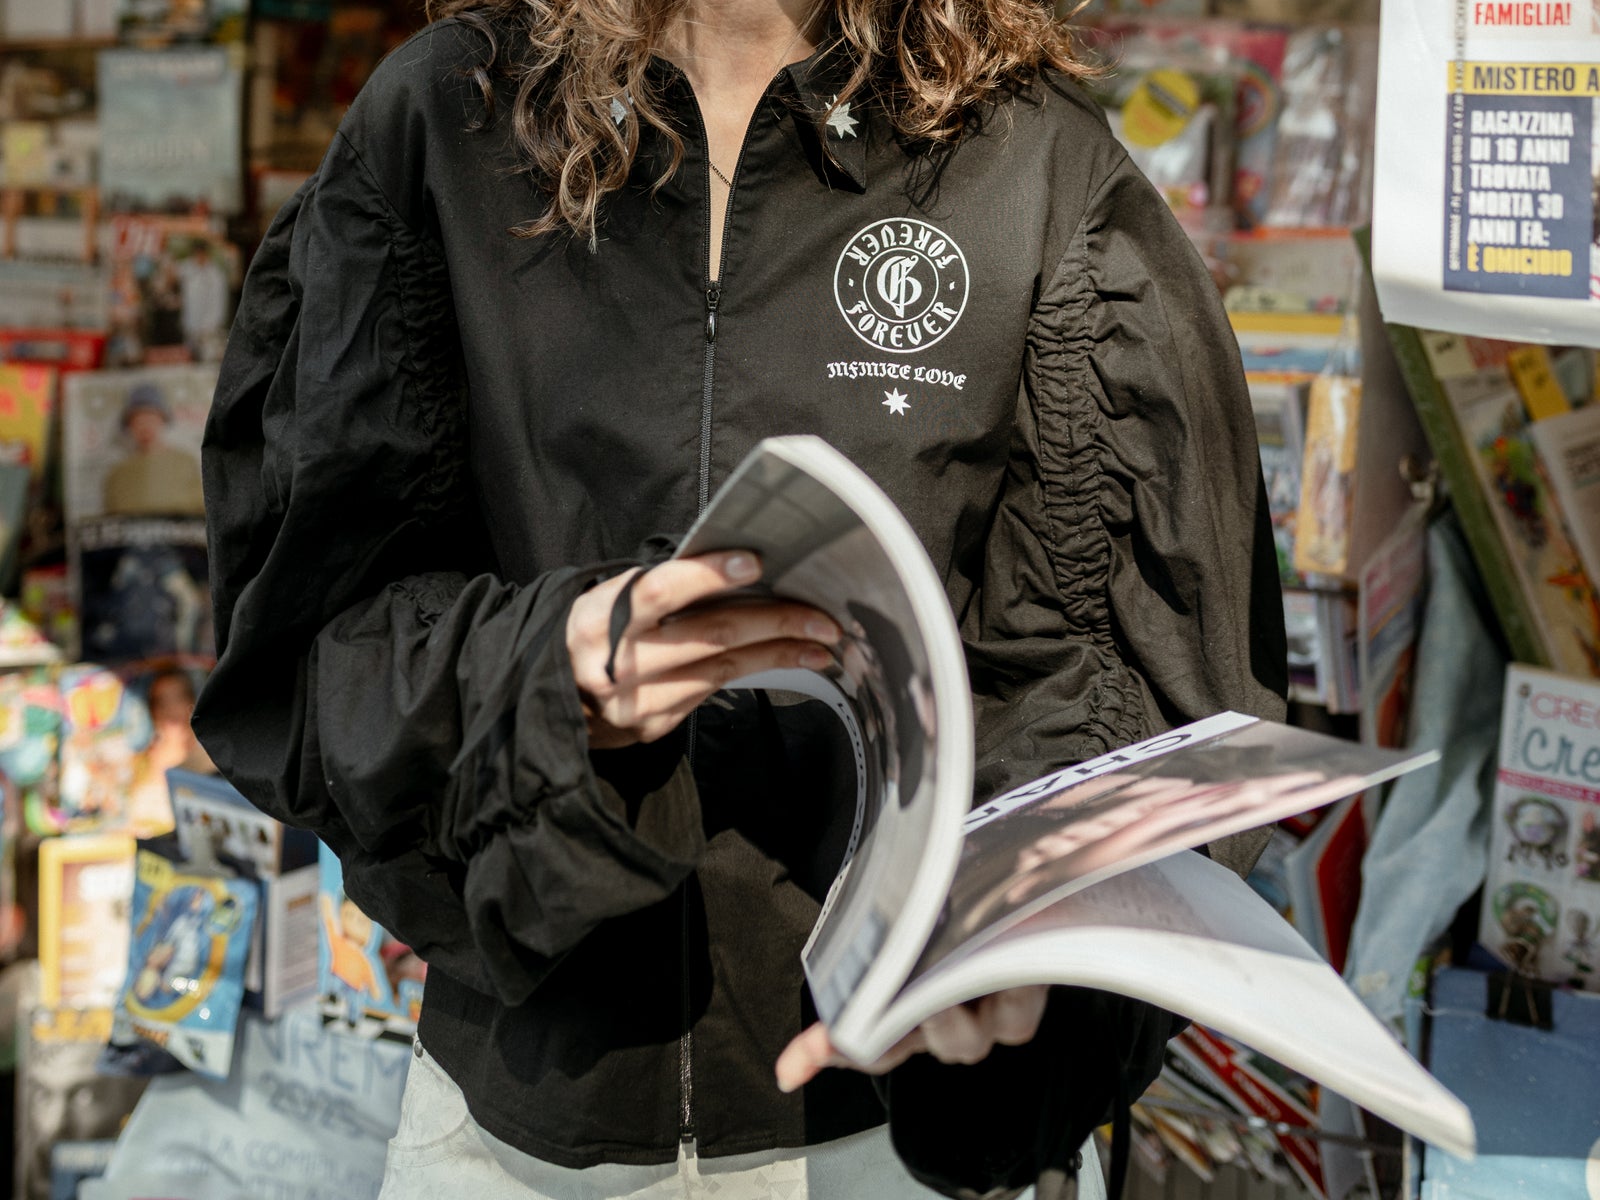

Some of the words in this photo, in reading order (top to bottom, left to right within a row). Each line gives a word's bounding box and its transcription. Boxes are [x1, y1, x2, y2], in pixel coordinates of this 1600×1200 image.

[1474, 1, 1571, 26] FAMIGLIA!
[1473, 66, 1576, 91] MISTERO
[1470, 110, 1574, 137] RAGAZZINA
[1470, 136, 1491, 161] DI
[1495, 137, 1517, 162] 16
[1520, 138, 1570, 164] ANNI
[1469, 163, 1551, 191] TROVATA
[1468, 191, 1534, 218] MORTA
[1537, 193, 1564, 220] 30
[846, 223, 959, 270] FOREVER
[1467, 218, 1517, 246] ANNI
[1520, 220, 1550, 247] FA:
[1483, 246, 1573, 277] OMICIDIO
[845, 300, 958, 348] FOREVER
[827, 361, 911, 381] INFINITE
[913, 365, 968, 391] LOVE
